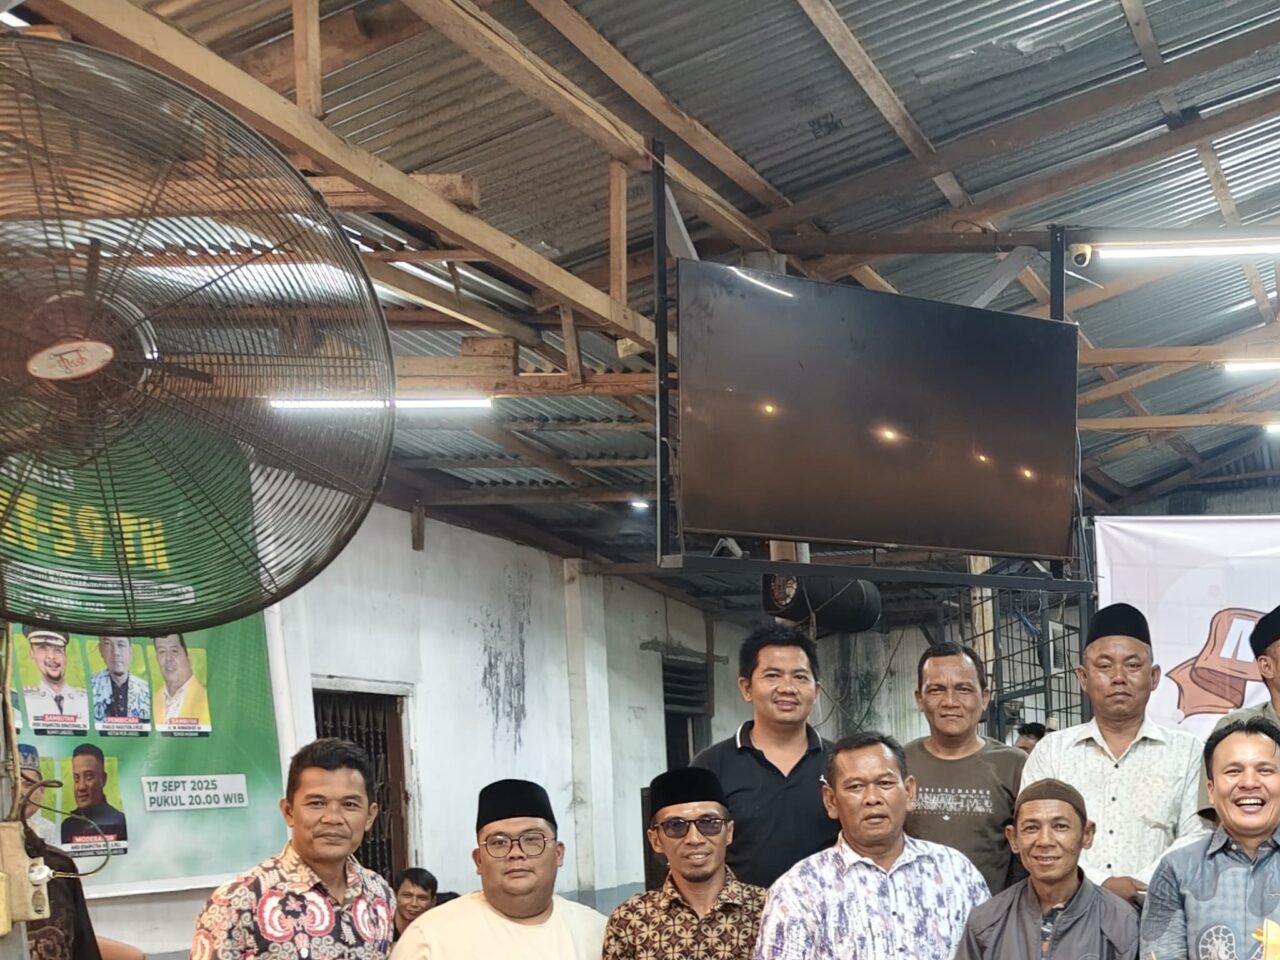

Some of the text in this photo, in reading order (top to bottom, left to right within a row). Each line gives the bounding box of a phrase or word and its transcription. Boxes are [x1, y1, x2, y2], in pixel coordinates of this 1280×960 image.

[147, 779, 218, 792] 17 SEPT 2025
[149, 793, 245, 807] PUKUL 20.00 WIB
